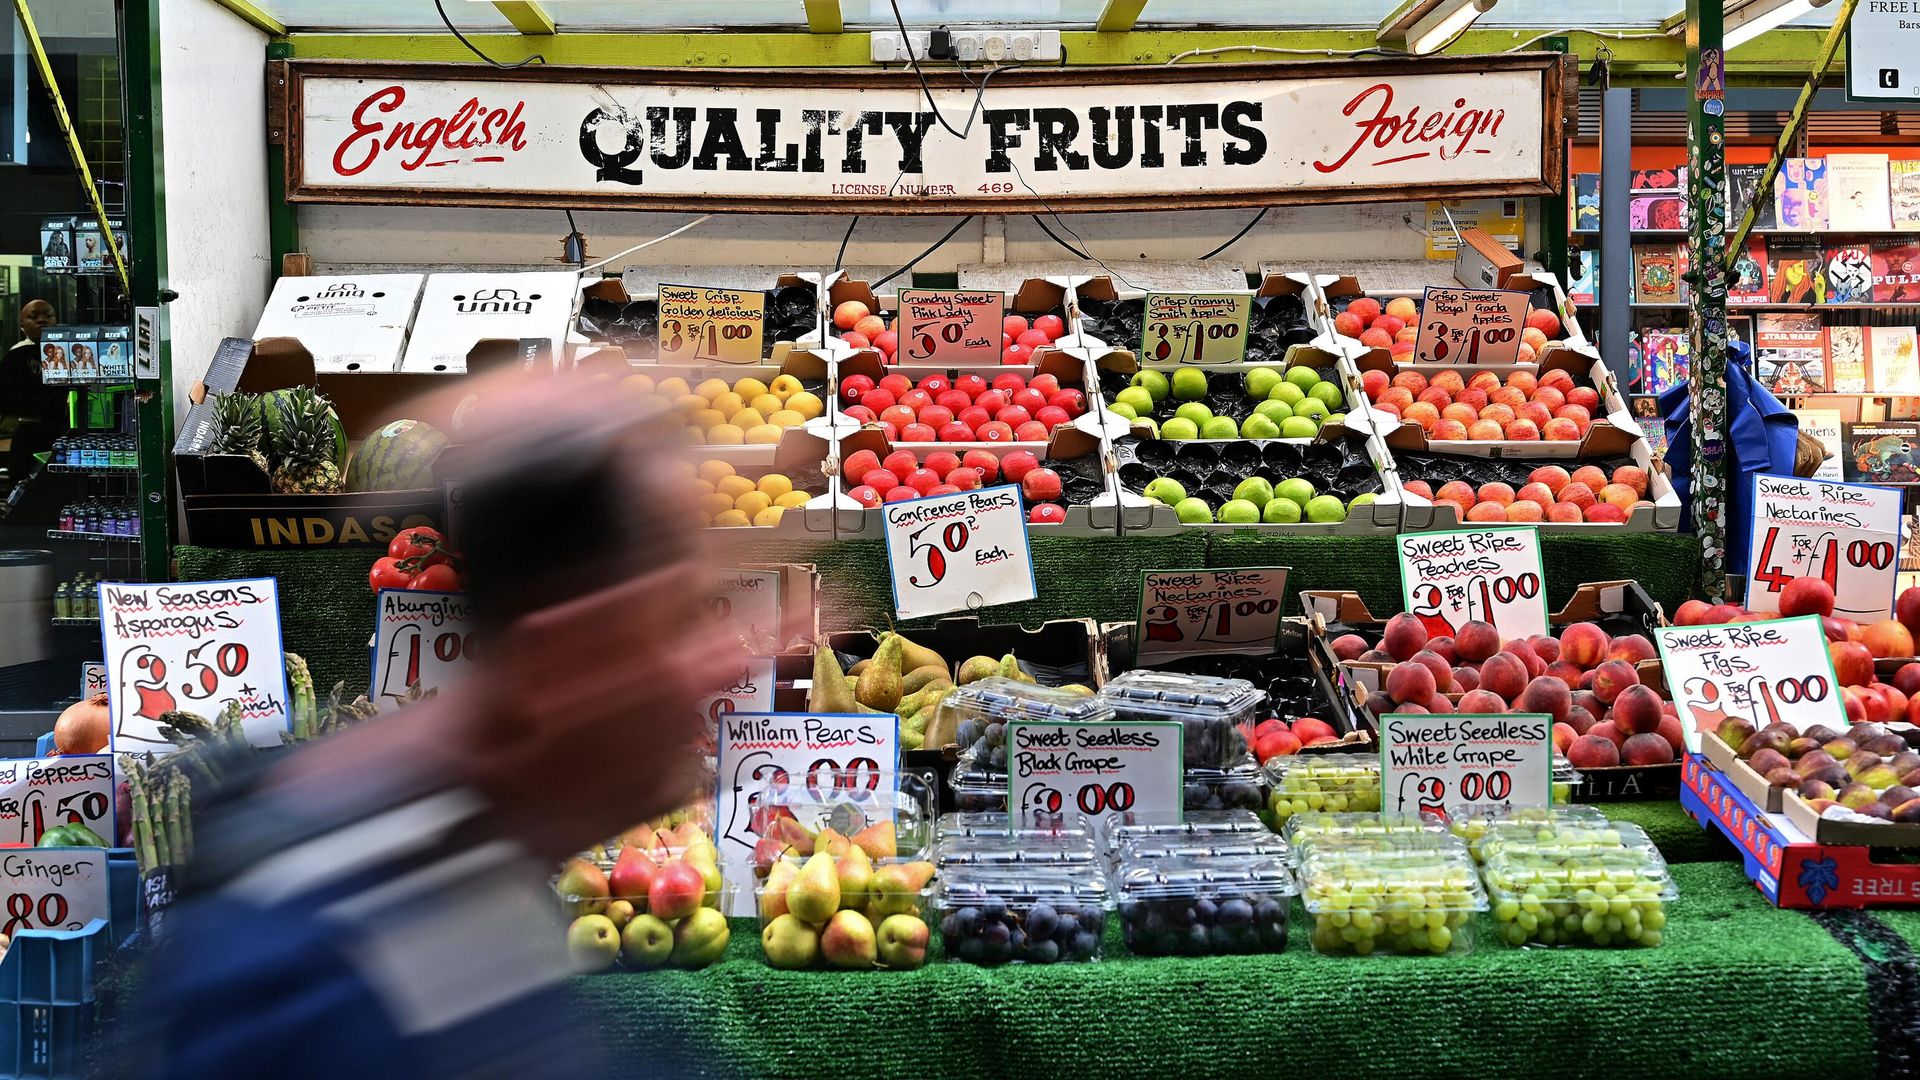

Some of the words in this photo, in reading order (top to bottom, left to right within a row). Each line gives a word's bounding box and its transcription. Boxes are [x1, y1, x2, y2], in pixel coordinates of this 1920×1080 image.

[1870, 1, 1909, 13] FREE
[333, 86, 527, 176] English
[1313, 83, 1505, 173] Foreign
[578, 105, 938, 185] QUALITY
[981, 101, 1268, 173] FRUITS
[831, 184, 887, 195] LICENSE
[900, 185, 957, 195] NUMBER
[977, 183, 1014, 194] 469
[1453, 219, 1478, 227] icensing
[661, 287, 698, 300] Sweet
[705, 290, 740, 304] Crisp
[901, 291, 953, 310] Crunchy
[954, 293, 997, 304] Sweet
[1149, 296, 1187, 309] Crisp
[1189, 296, 1236, 312] Granny
[1427, 290, 1458, 304] Crisp
[1461, 292, 1502, 301] Sweet
[661, 303, 704, 316] Golden
[707, 306, 762, 318] delicious
[911, 306, 936, 318] Pink
[938, 307, 974, 323] Lady
[1149, 308, 1187, 319] Smith
[1190, 309, 1227, 319] Apple
[1435, 302, 1468, 316] Royal
[1472, 314, 1513, 325] Apples
[661, 320, 683, 352] 3
[965, 337, 991, 347] Each
[1144, 322, 1172, 361] 3
[1420, 321, 1449, 362] 3
[1758, 478, 1810, 496] Sweet
[1819, 484, 1867, 504] Ripe
[889, 500, 966, 524] Confrence
[967, 493, 1014, 509] Pears
[1766, 502, 1862, 528] Nectarines
[975, 545, 1009, 562] Each
[1403, 535, 1464, 558] Sweet
[1467, 532, 1521, 553] Ripe
[1412, 556, 1501, 577] Peaches
[1754, 527, 1795, 592] 4
[1791, 534, 1812, 551] FOR
[1146, 573, 1202, 587] Sweet
[1210, 571, 1264, 585] Ripe
[107, 587, 147, 606] New
[156, 586, 257, 607] Seasons
[1155, 586, 1262, 602] Nectarines
[1413, 583, 1456, 641] 2
[1445, 584, 1465, 599] FOR
[113, 611, 239, 639] Asparagus
[1143, 605, 1184, 643] 2
[1184, 606, 1207, 616] FOR
[1663, 630, 1722, 649] Sweet
[1723, 626, 1782, 647] Ripe
[1699, 651, 1750, 677] Figs
[1683, 676, 1729, 734] 2
[1723, 681, 1748, 694] FOR
[727, 718, 798, 741] William
[803, 718, 876, 744] Pears
[1016, 726, 1070, 748] Sweet
[1076, 728, 1160, 748] Seedless
[1388, 720, 1457, 744] Sweet
[1459, 720, 1546, 741] Seedless
[1014, 751, 1061, 778] Black
[1065, 752, 1126, 775] Grape
[1390, 745, 1449, 766] White
[1453, 744, 1524, 767] Grape
[25, 761, 111, 786] Peppers
[3, 855, 93, 887] Ginger
[1852, 878, 1905, 896] TREE
